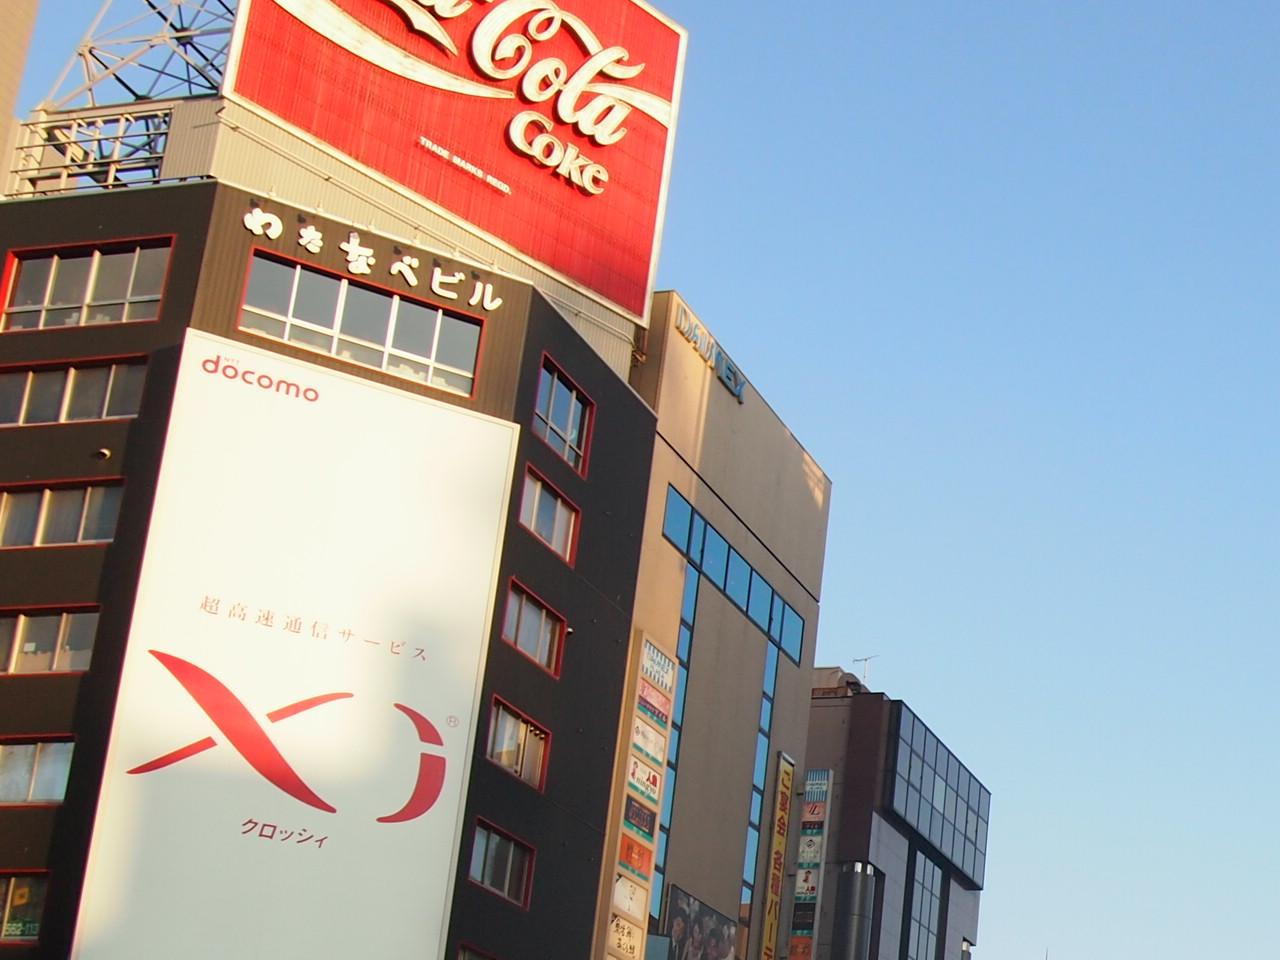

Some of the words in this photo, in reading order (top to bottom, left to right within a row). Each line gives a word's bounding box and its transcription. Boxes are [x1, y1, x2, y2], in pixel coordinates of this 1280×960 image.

[419, 136, 451, 160] TRADE
[508, 110, 610, 195] Coke
[243, 207, 504, 310] わたなべビル
[202, 355, 319, 402] docomo
[199, 594, 427, 661] 超高速通信サービス
